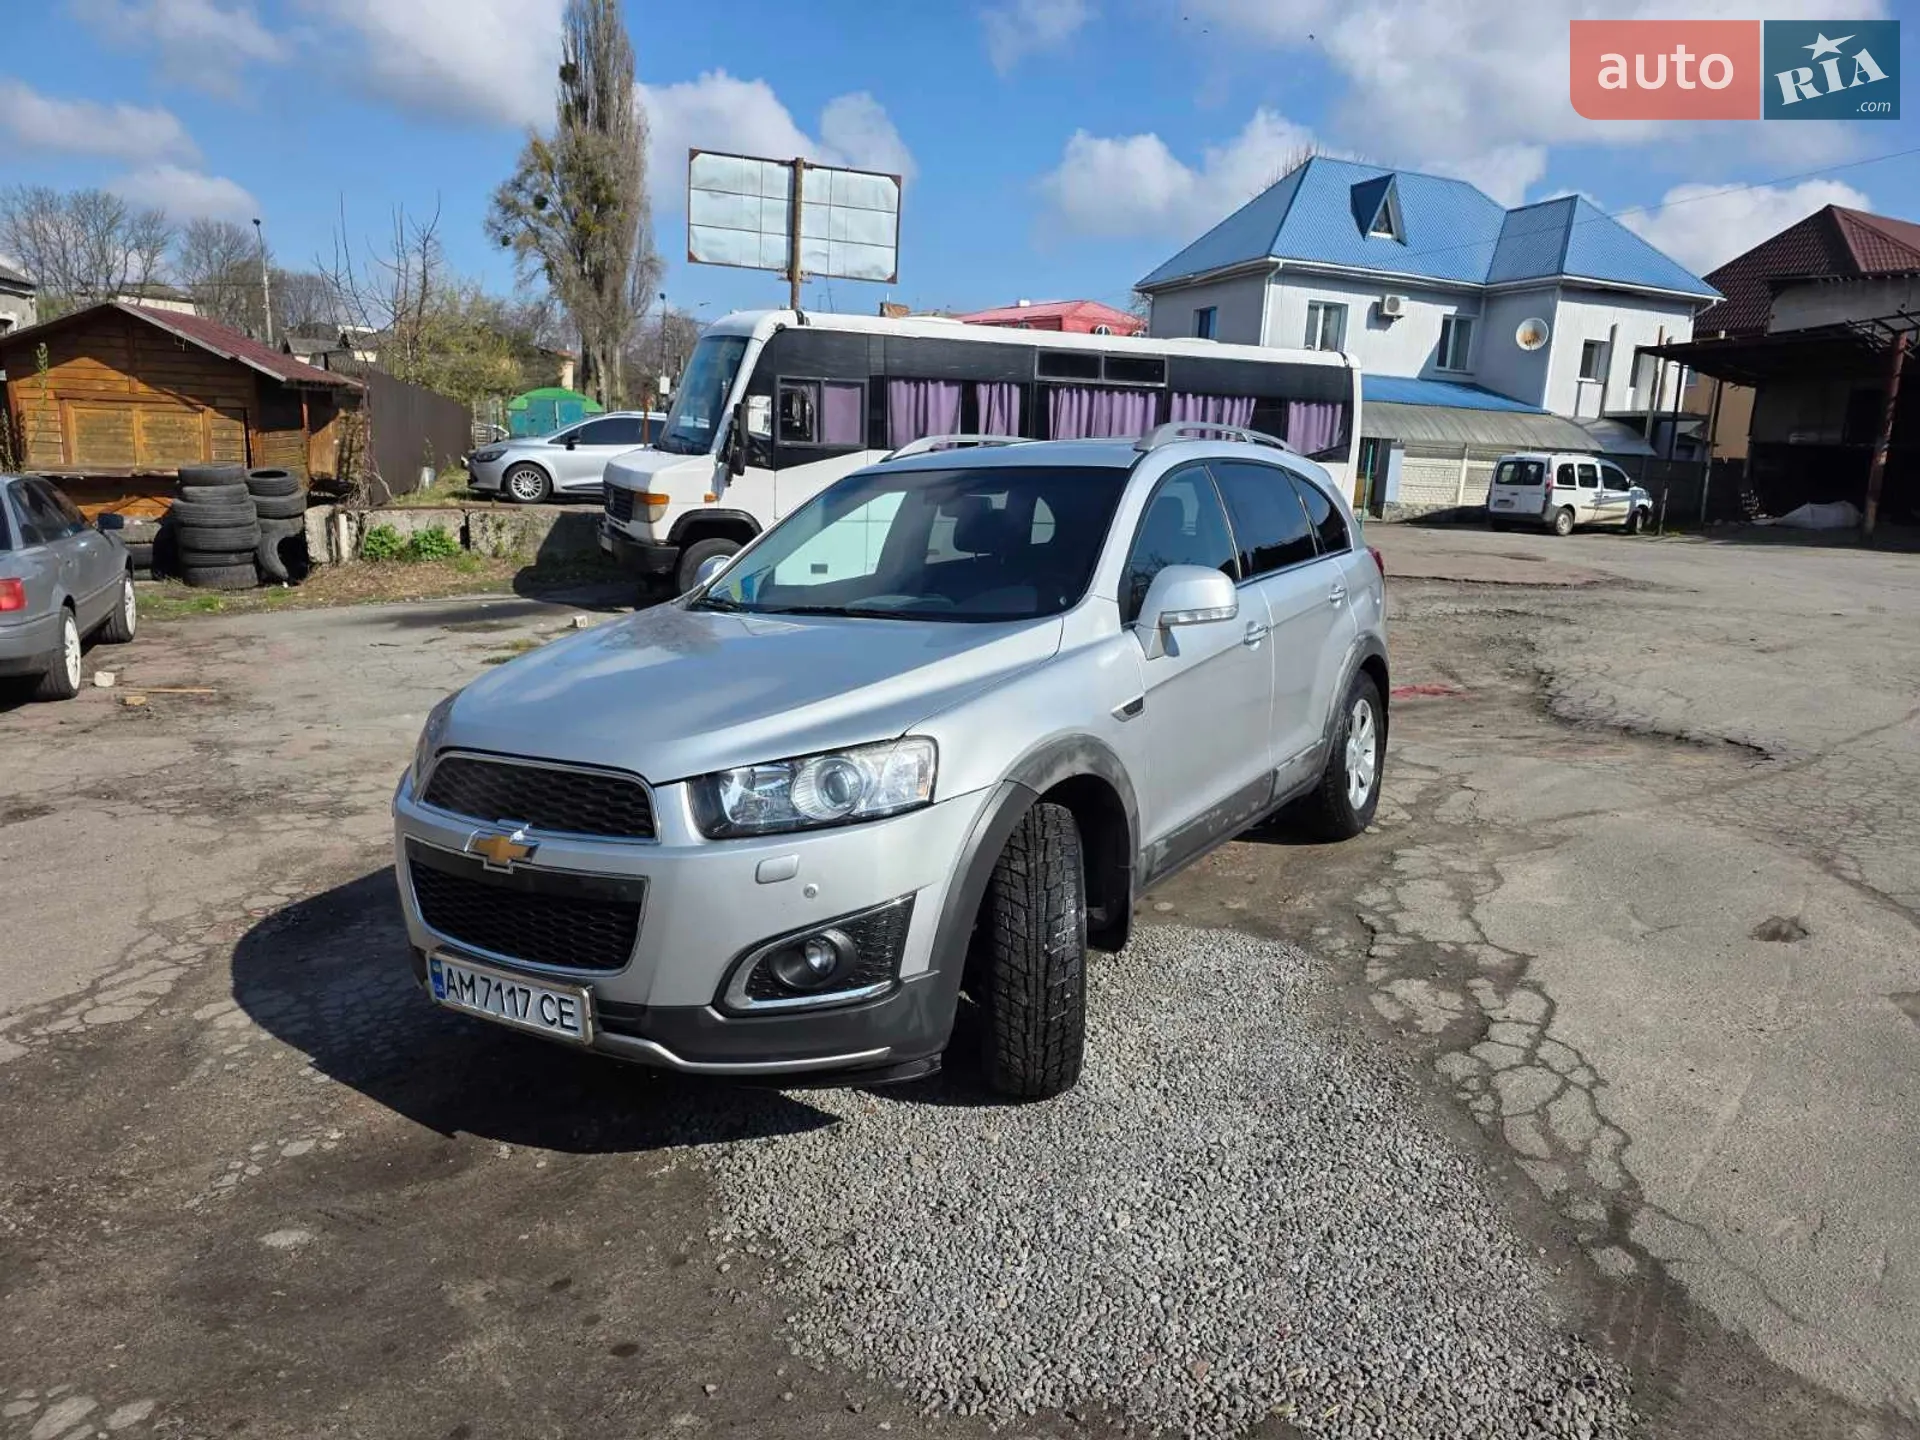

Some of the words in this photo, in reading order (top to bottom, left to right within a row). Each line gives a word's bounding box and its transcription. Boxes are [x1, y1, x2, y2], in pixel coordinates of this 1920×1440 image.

[446, 967, 477, 1004] AM
[480, 978, 532, 1019] 7117
[540, 993, 578, 1031] CE
